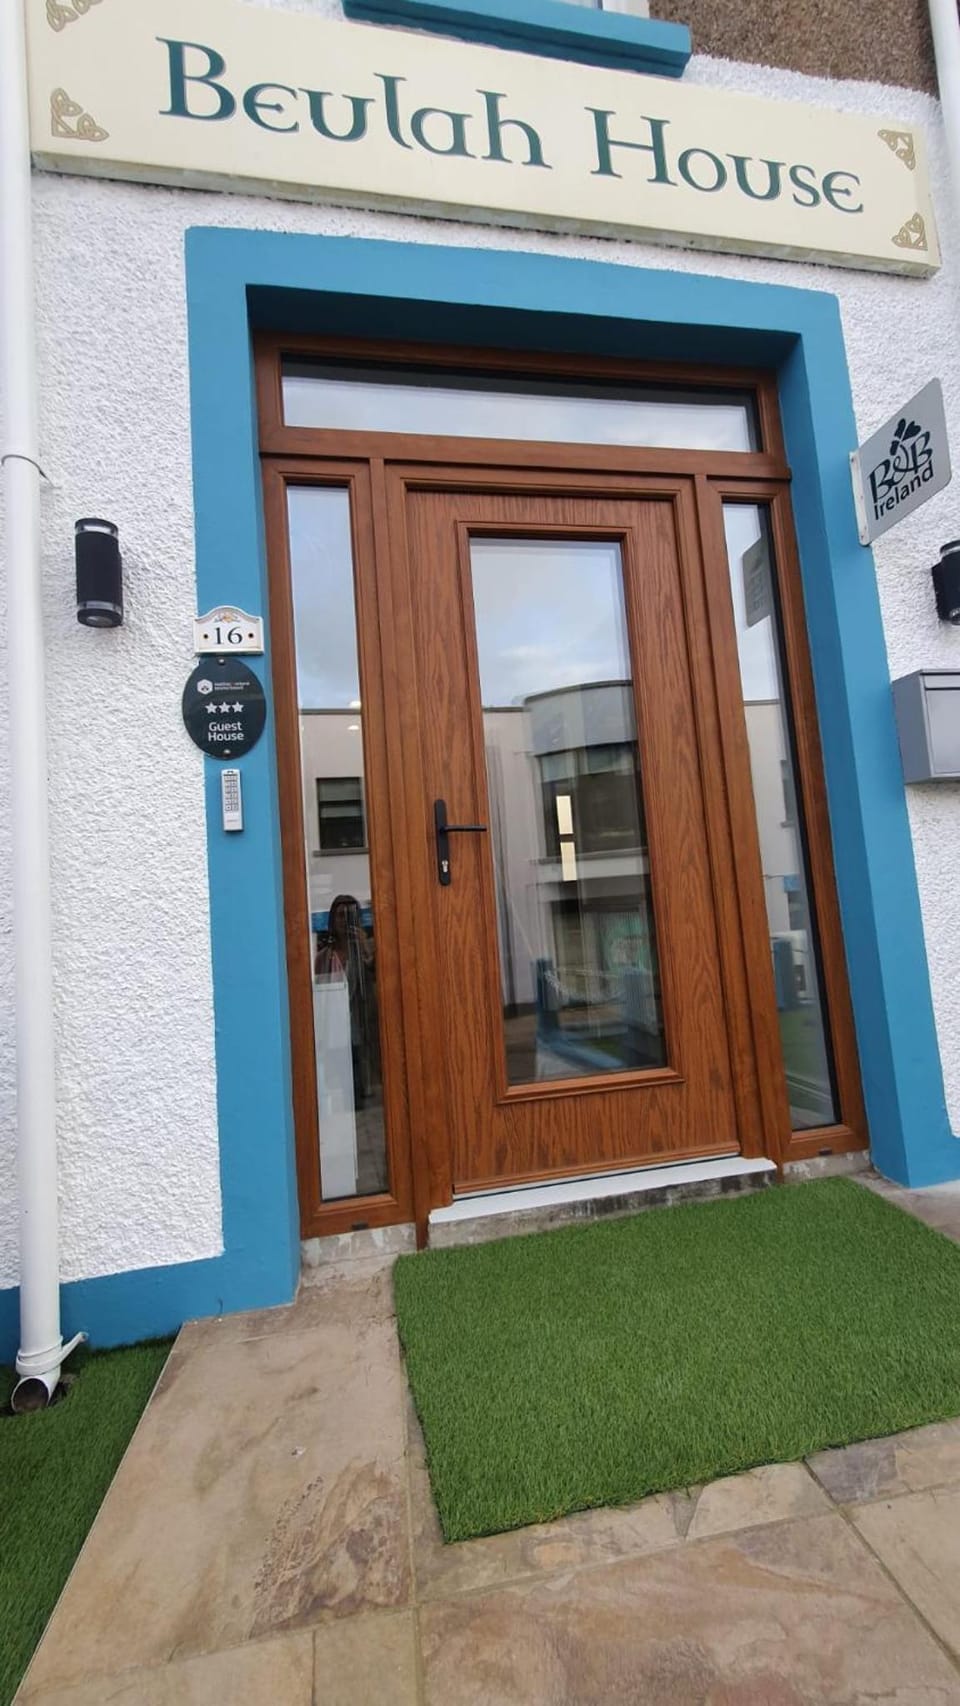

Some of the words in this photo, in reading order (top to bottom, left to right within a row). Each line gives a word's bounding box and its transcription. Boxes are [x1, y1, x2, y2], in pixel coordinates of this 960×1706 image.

[155, 36, 553, 169] Beulah
[584, 106, 865, 214] House
[868, 431, 933, 503] B&B
[873, 460, 934, 520] Ireland
[214, 626, 243, 645] 16
[208, 721, 242, 731] Guest
[208, 732, 244, 741] House
